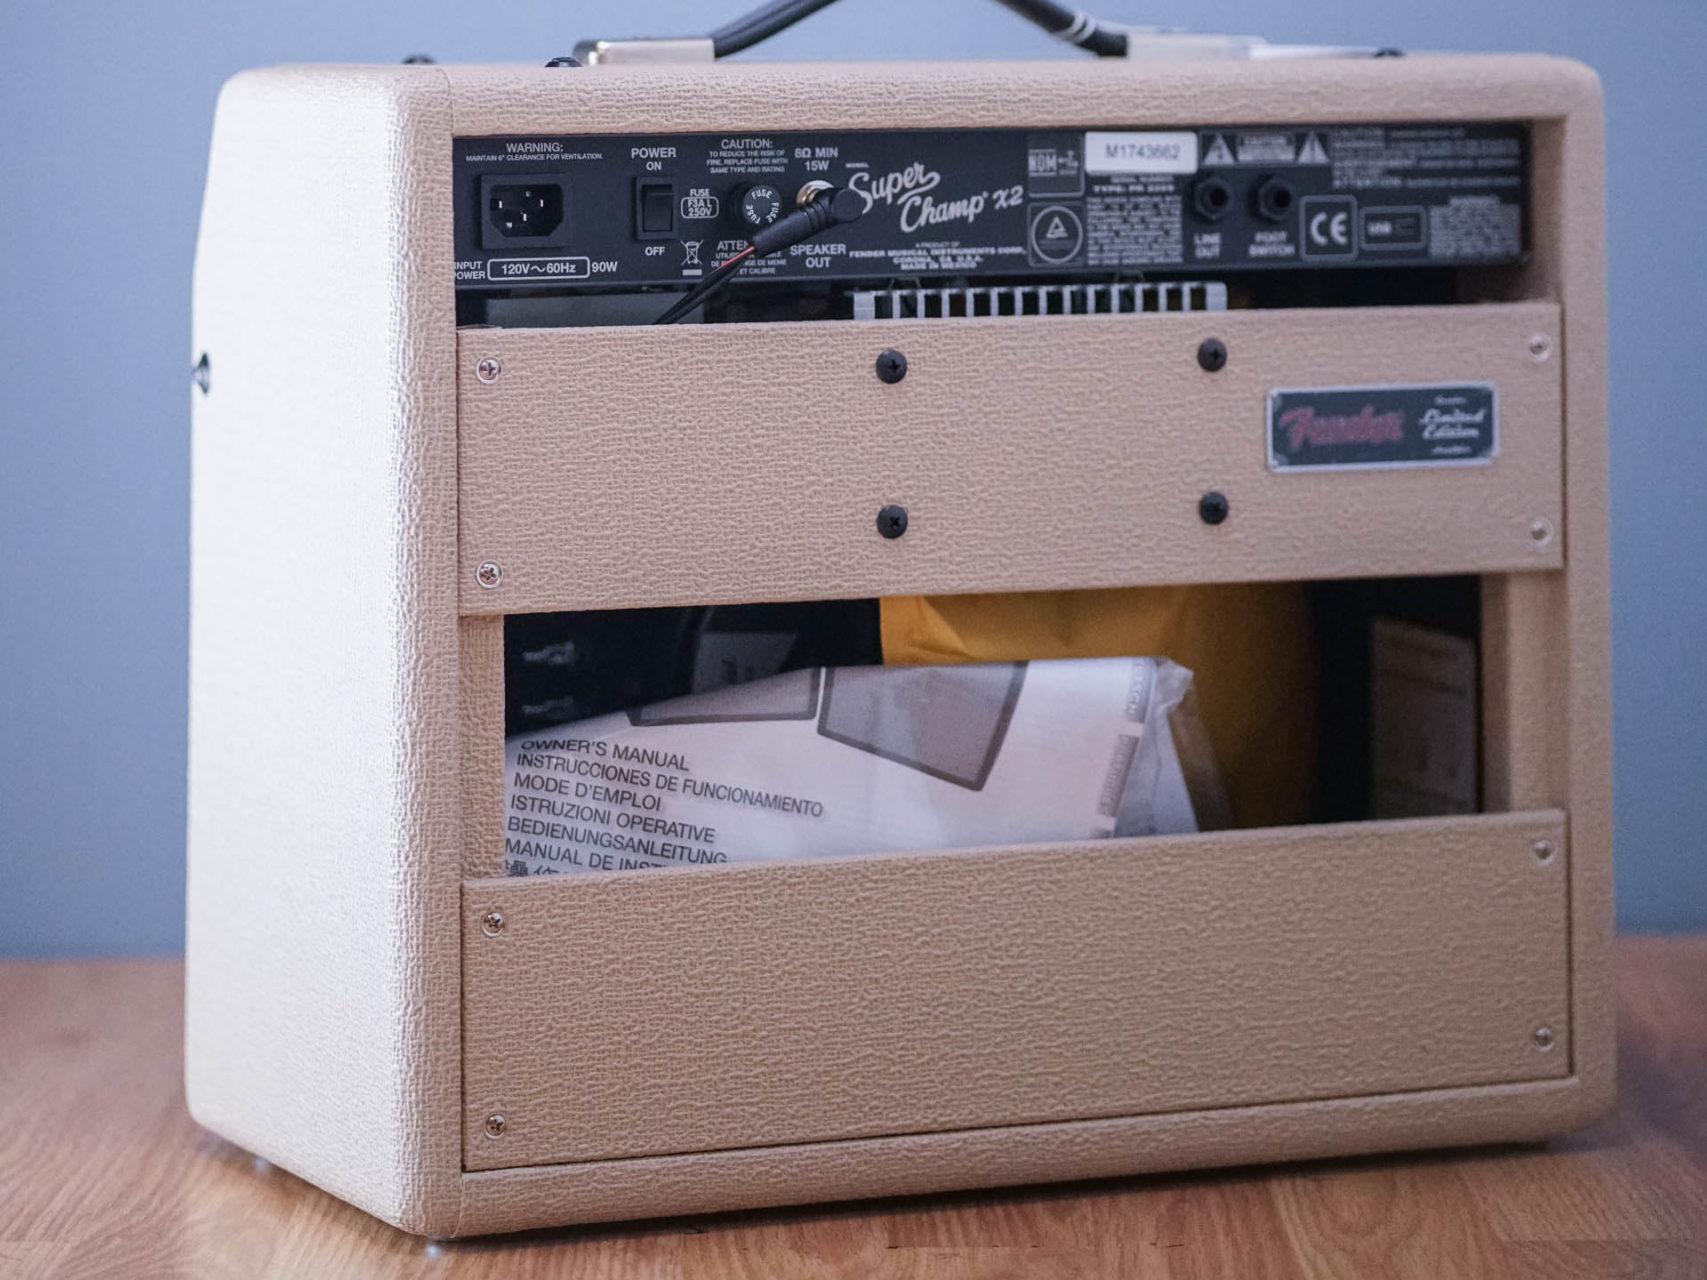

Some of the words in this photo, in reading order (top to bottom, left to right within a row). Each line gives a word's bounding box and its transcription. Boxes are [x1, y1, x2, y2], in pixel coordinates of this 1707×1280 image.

[506, 142, 564, 153] WARNING:
[721, 139, 774, 149] CAUTION:
[631, 147, 677, 159] POWER
[815, 146, 838, 158] MIN
[646, 161, 662, 171] ON
[804, 160, 829, 171] 15W
[690, 188, 710, 197] FUSE
[751, 189, 772, 199] FUSE
[848, 162, 941, 215] Super
[688, 208, 712, 217] 250V
[746, 204, 760, 224] FUSE
[766, 202, 779, 223] FUSE
[900, 195, 984, 232] Champ
[645, 246, 666, 258] OFF
[790, 243, 846, 255] SPEAKER
[849, 250, 886, 258] FENDER
[591, 261, 618, 272] 90W
[805, 257, 831, 268] OUT
[521, 739, 607, 756] OWNER'S
[612, 744, 690, 771] MANUAL
[514, 772, 570, 795] MODE
[574, 782, 662, 811] D'EMPLOI
[516, 754, 651, 787] INSTRUCCIONES
[655, 773, 679, 791] DE
[682, 778, 824, 817] FUNCIONAMIENTO
[511, 794, 611, 825] ISTRUZIONI
[616, 813, 715, 843] OPERATIVE
[507, 816, 727, 864] BEDIENUNGSANLEITUNG
[506, 838, 583, 866] MANUAL
[588, 852, 614, 871] DE
